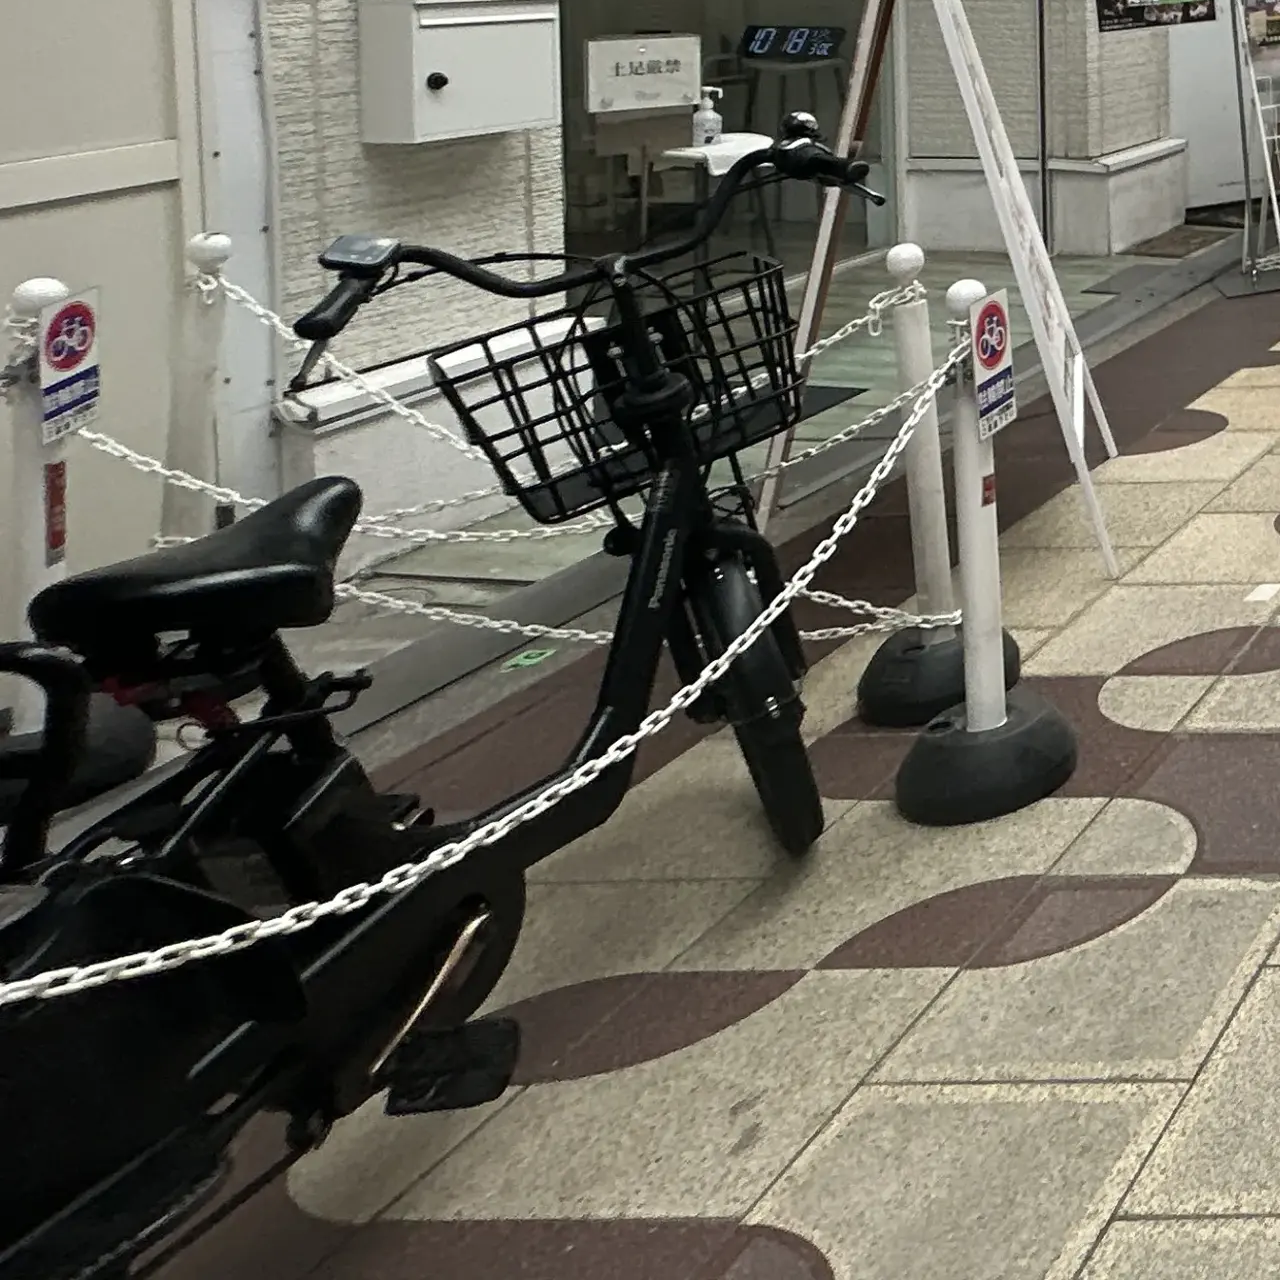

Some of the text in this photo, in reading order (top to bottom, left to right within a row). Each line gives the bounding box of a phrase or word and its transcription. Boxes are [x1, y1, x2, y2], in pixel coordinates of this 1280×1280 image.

[607, 58, 682, 77] 土足厳禁
[648, 528, 679, 609] Panasonic
